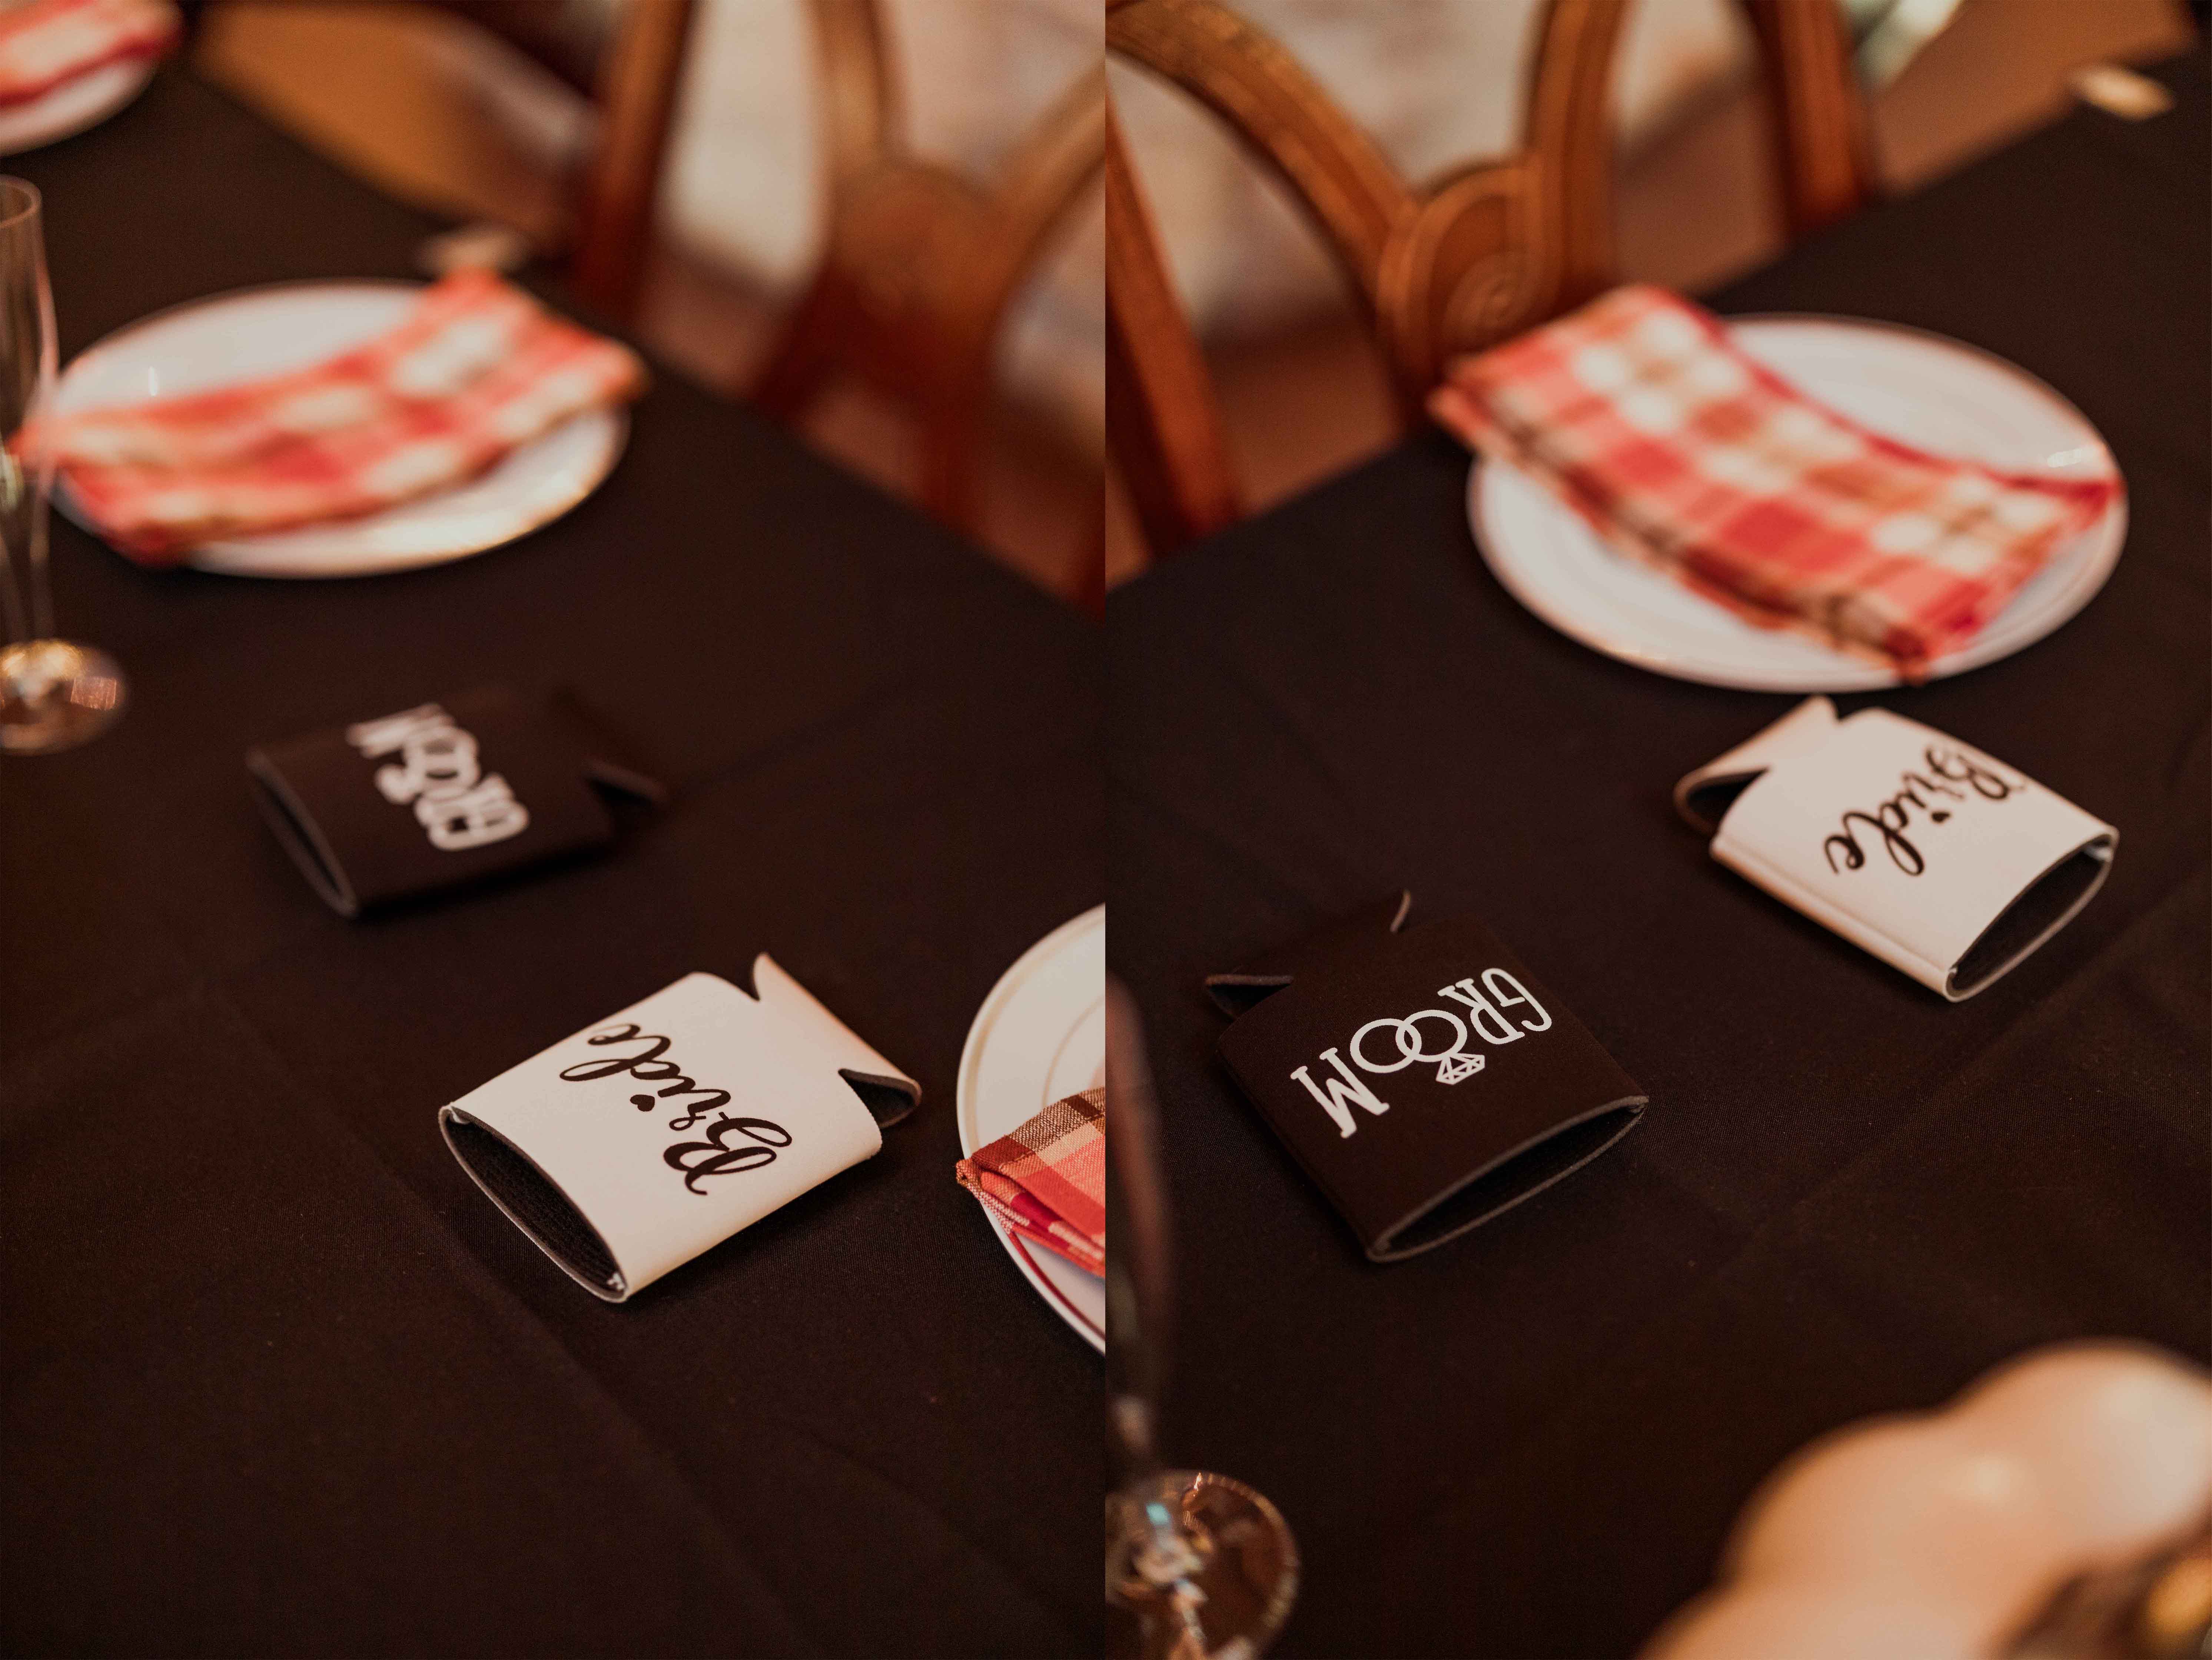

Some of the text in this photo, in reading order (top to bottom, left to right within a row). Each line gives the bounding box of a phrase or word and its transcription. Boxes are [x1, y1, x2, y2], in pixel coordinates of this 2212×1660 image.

[1824, 743, 2027, 876] Bride
[559, 1023, 792, 1195] Bride
[1290, 968, 1552, 1138] GROOM
